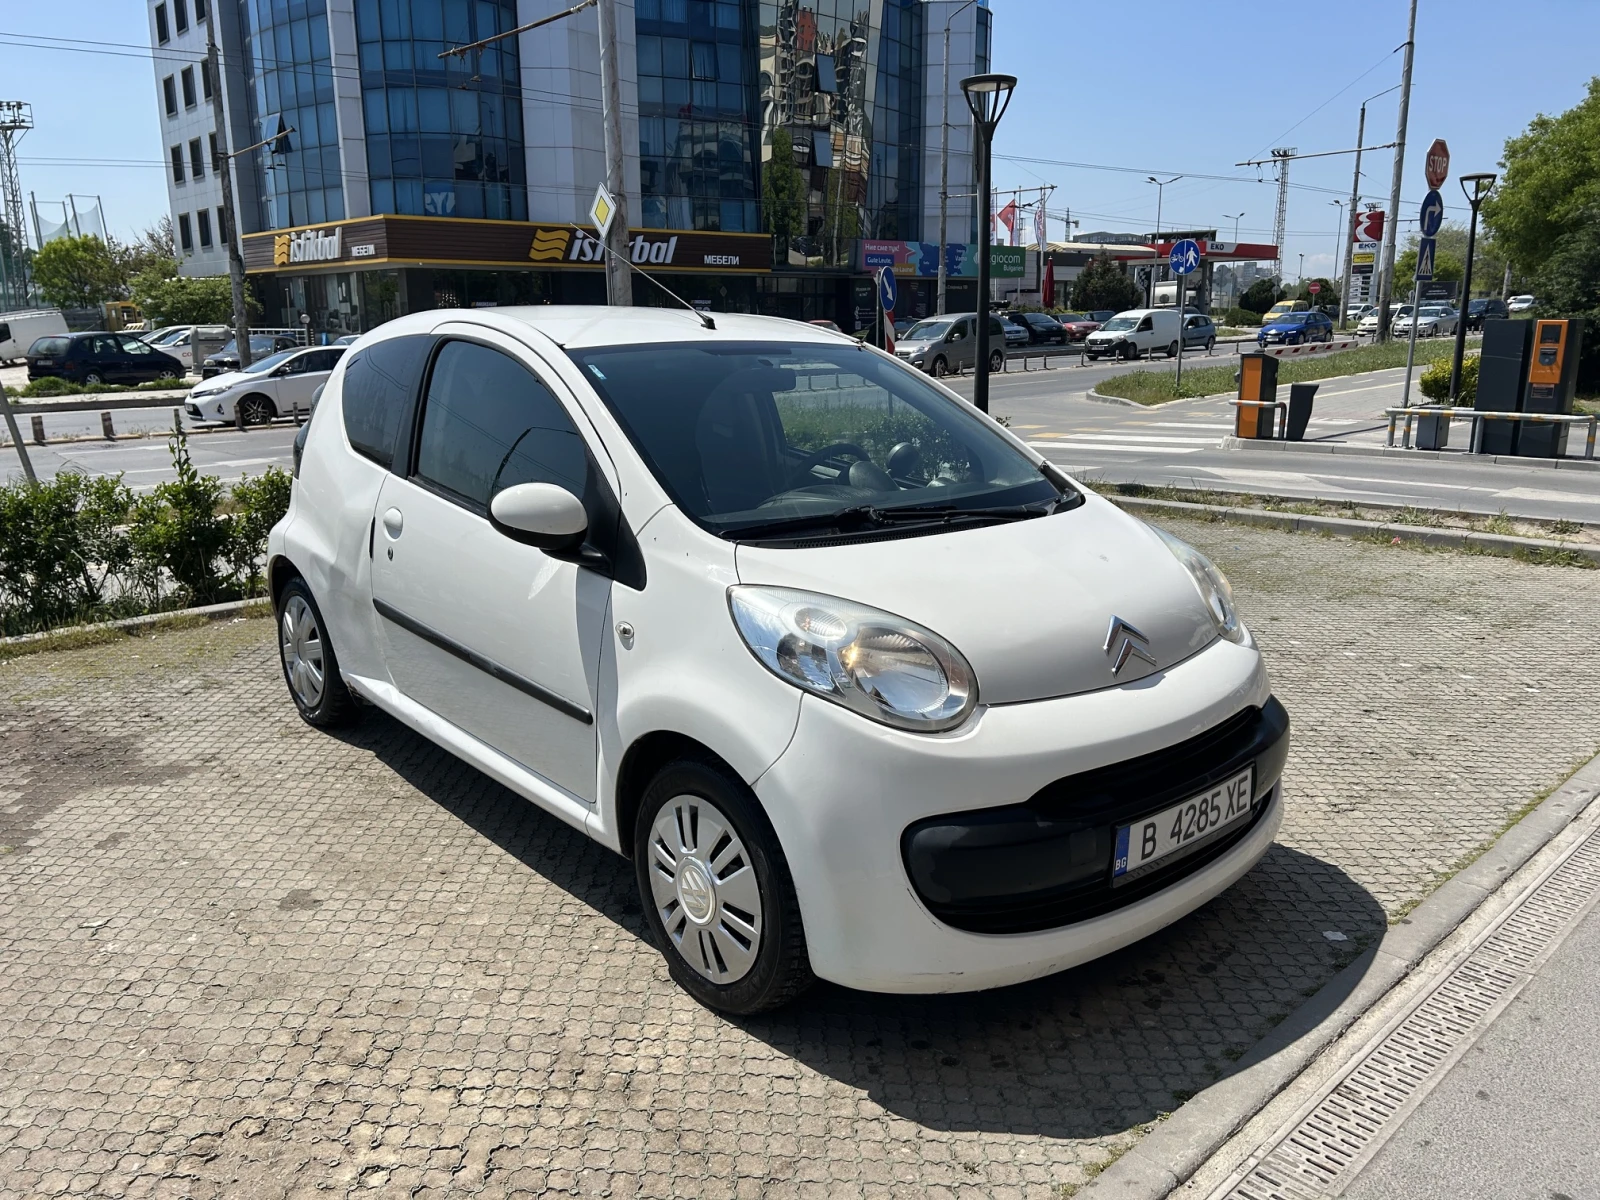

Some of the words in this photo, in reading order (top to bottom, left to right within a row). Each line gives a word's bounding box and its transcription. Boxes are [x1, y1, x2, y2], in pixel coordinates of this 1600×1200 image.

[1429, 155, 1447, 173] STOP
[290, 227, 342, 262] istikbal
[569, 230, 678, 263] istbal
[703, 254, 740, 265] МЕБЕЛИ
[990, 252, 1021, 265] giocom
[1003, 264, 1024, 272] Bulgarien
[1140, 821, 1157, 861] B
[1169, 789, 1222, 845] 4285
[1224, 774, 1249, 821] XE
[1114, 856, 1127, 871] BG
